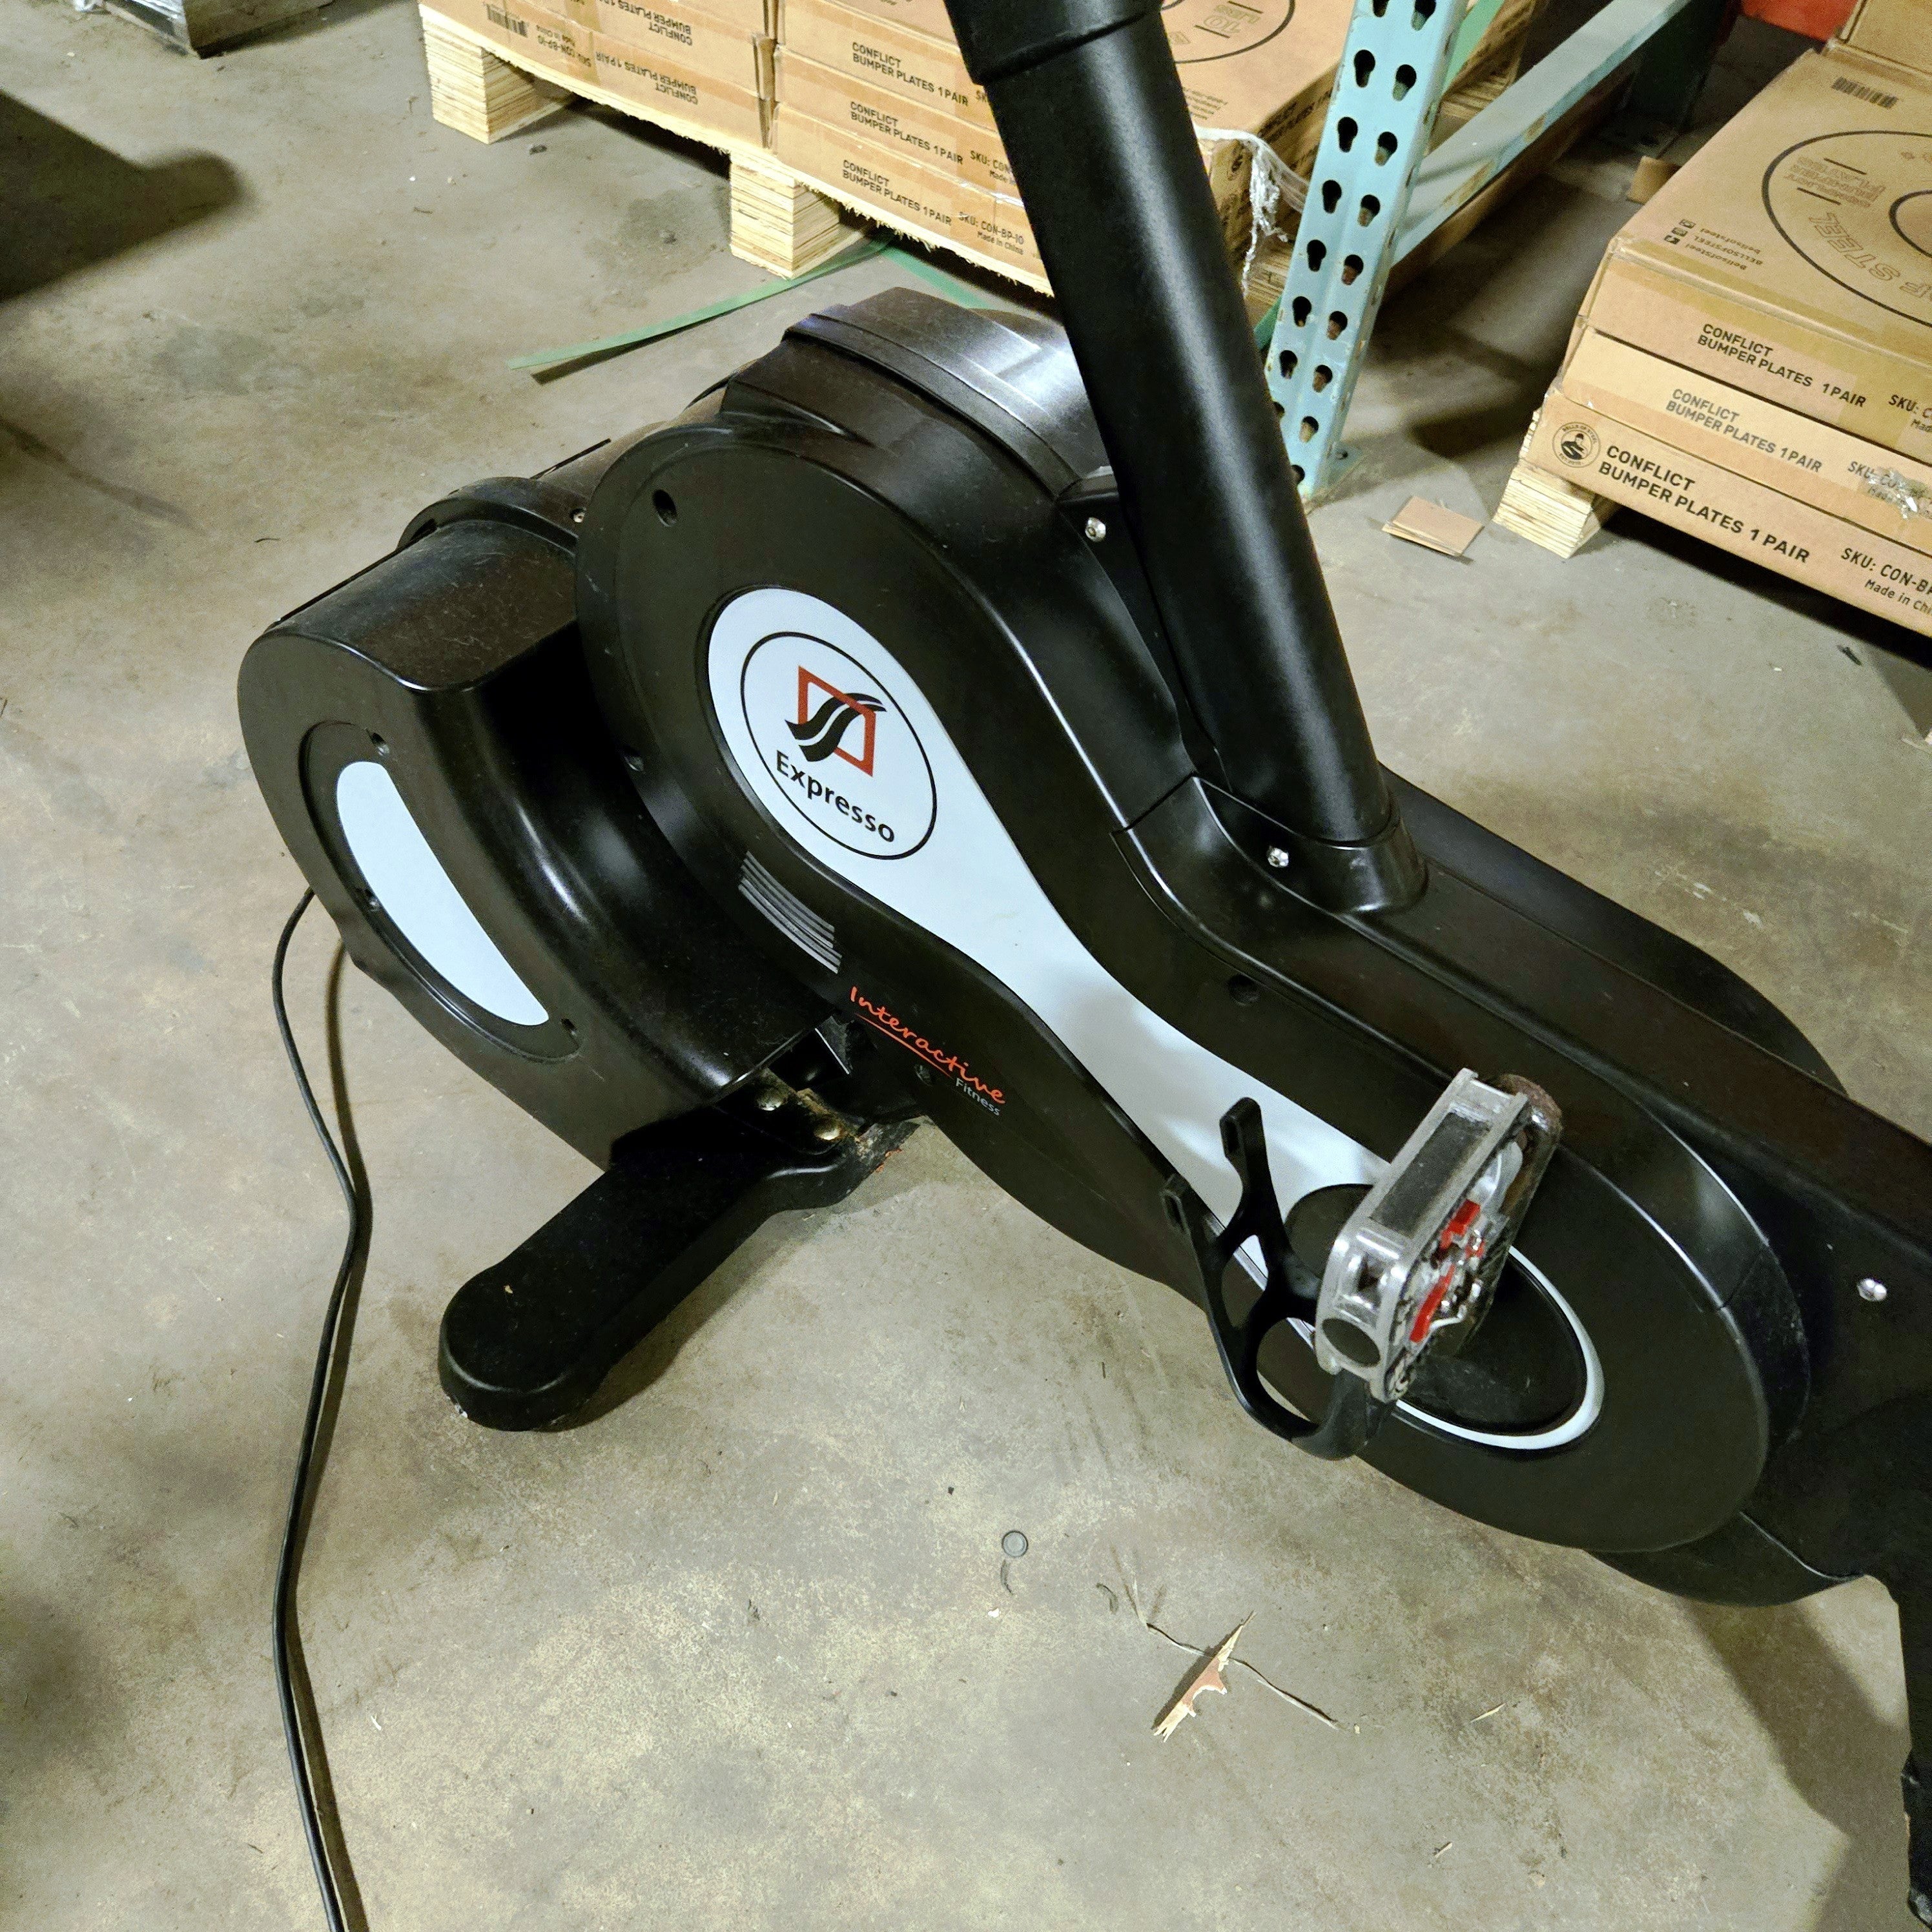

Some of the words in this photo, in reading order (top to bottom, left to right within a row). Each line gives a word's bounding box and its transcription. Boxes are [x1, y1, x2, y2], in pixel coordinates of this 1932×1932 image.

[618, 0, 652, 19] PLATES
[653, 12, 692, 34] BUMPER
[648, 22, 693, 46] CONFLICT
[624, 61, 658, 81] PLATES
[852, 42, 901, 68] CONFLICT
[659, 74, 697, 96] BUMPER
[852, 53, 894, 77] BUMPER
[897, 70, 934, 93] PLATES
[655, 83, 699, 105] CONFLICT
[850, 101, 898, 127] CONFLICT
[850, 112, 891, 137] BUMPER
[894, 129, 930, 151] PLATES
[842, 160, 890, 187] CONFLICT
[842, 169, 882, 195] BUMPER
[884, 188, 921, 212] PLATES
[981, 220, 1024, 245] CON-BP-10
[1694, 235, 1763, 265] BELLSOFSTEEL
[1809, 212, 1901, 282] STEEL
[1703, 324, 1773, 356] CONFLICT
[1698, 334, 1756, 365] BUMPER
[1758, 359, 1813, 387] PLATES
[1888, 395, 1919, 415] SKU:
[1672, 389, 1740, 422] CONFLICT
[1665, 400, 1722, 431] BUMPER
[1723, 424, 1776, 453] PLATES
[1606, 446, 1696, 491] CONFLICT
[1599, 462, 1672, 503] BUMPER
[1674, 495, 1744, 534] PLATES
[1841, 548, 1876, 571] SKU:
[1864, 579, 1895, 599] Made
[1898, 592, 1911, 606] in
[1913, 600, 1932, 617] Chi
[776, 750, 895, 843] Expresso
[850, 986, 1005, 1104] Interactive
[956, 1077, 1000, 1116] Fitness
